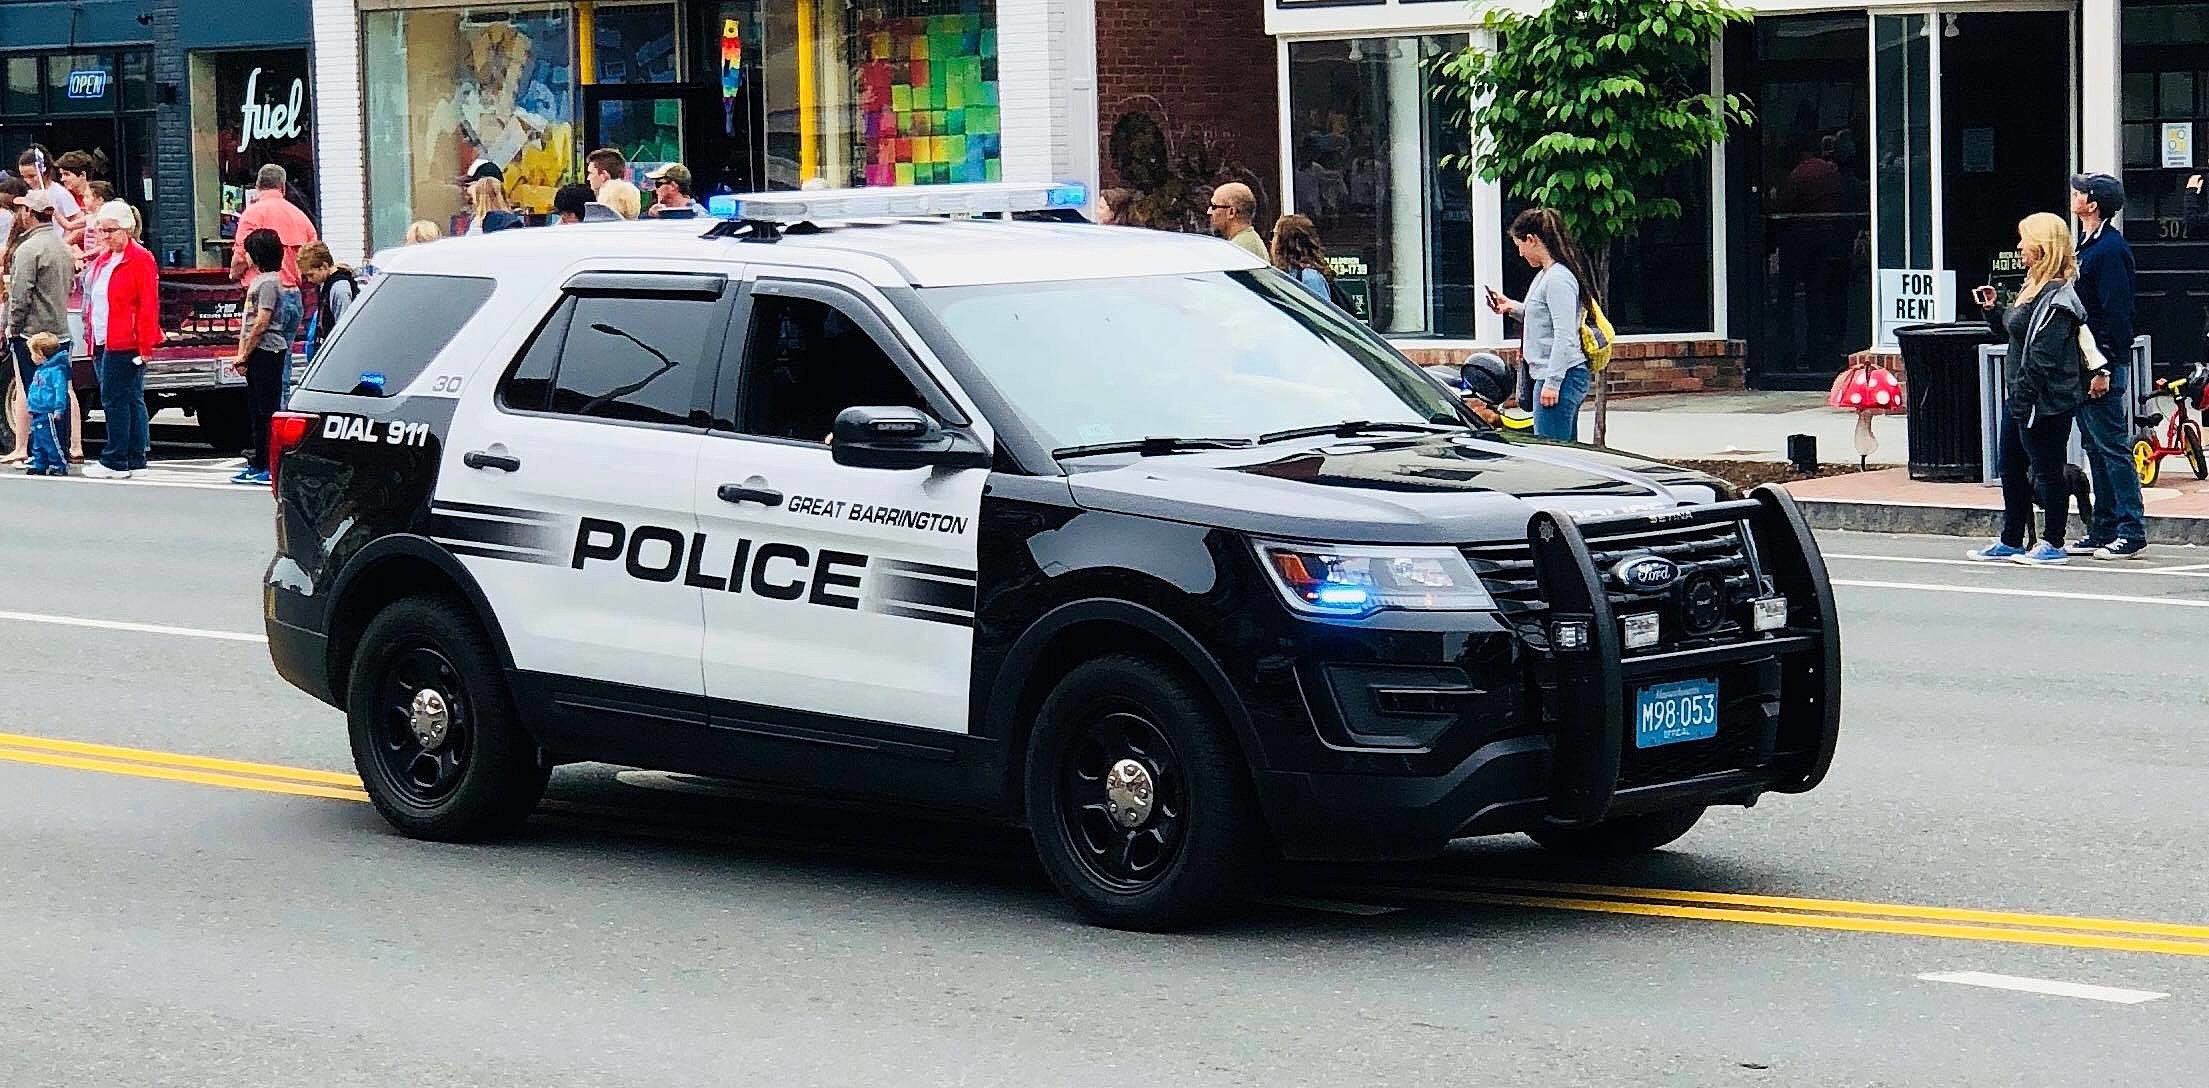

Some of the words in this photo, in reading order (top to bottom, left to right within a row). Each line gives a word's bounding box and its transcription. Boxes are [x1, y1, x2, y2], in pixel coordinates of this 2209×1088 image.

[72, 75, 103, 95] OPEN
[237, 67, 303, 153] fuel
[1902, 273, 1933, 295] FOR
[432, 375, 463, 393] 30
[322, 414, 379, 443] DIAL
[386, 420, 430, 447] 911
[788, 495, 846, 519] GREAT
[848, 503, 968, 535] BARRINGTON
[571, 516, 869, 611] POLICE
[1637, 562, 1671, 582] Ford
